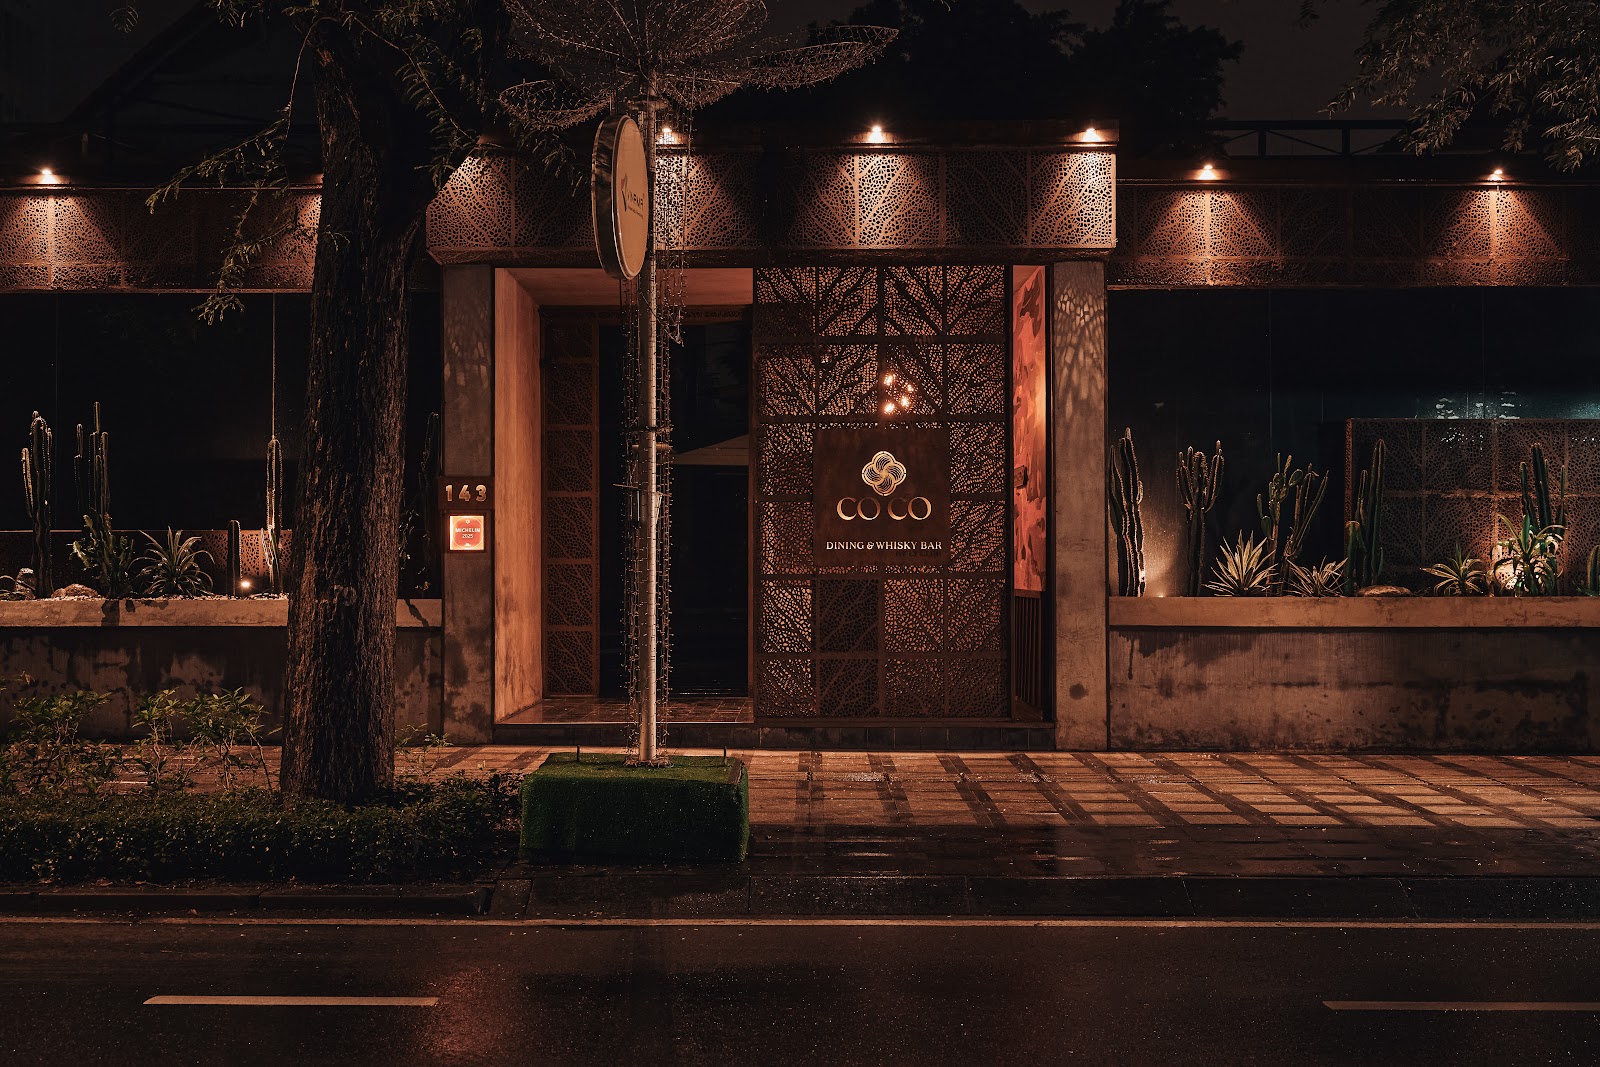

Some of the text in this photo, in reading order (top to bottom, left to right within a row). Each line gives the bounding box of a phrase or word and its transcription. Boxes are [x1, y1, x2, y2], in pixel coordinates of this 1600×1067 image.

[445, 484, 487, 502] 143
[836, 496, 932, 521] CO CO
[826, 541, 942, 550] DINING & WHISKY BAR
